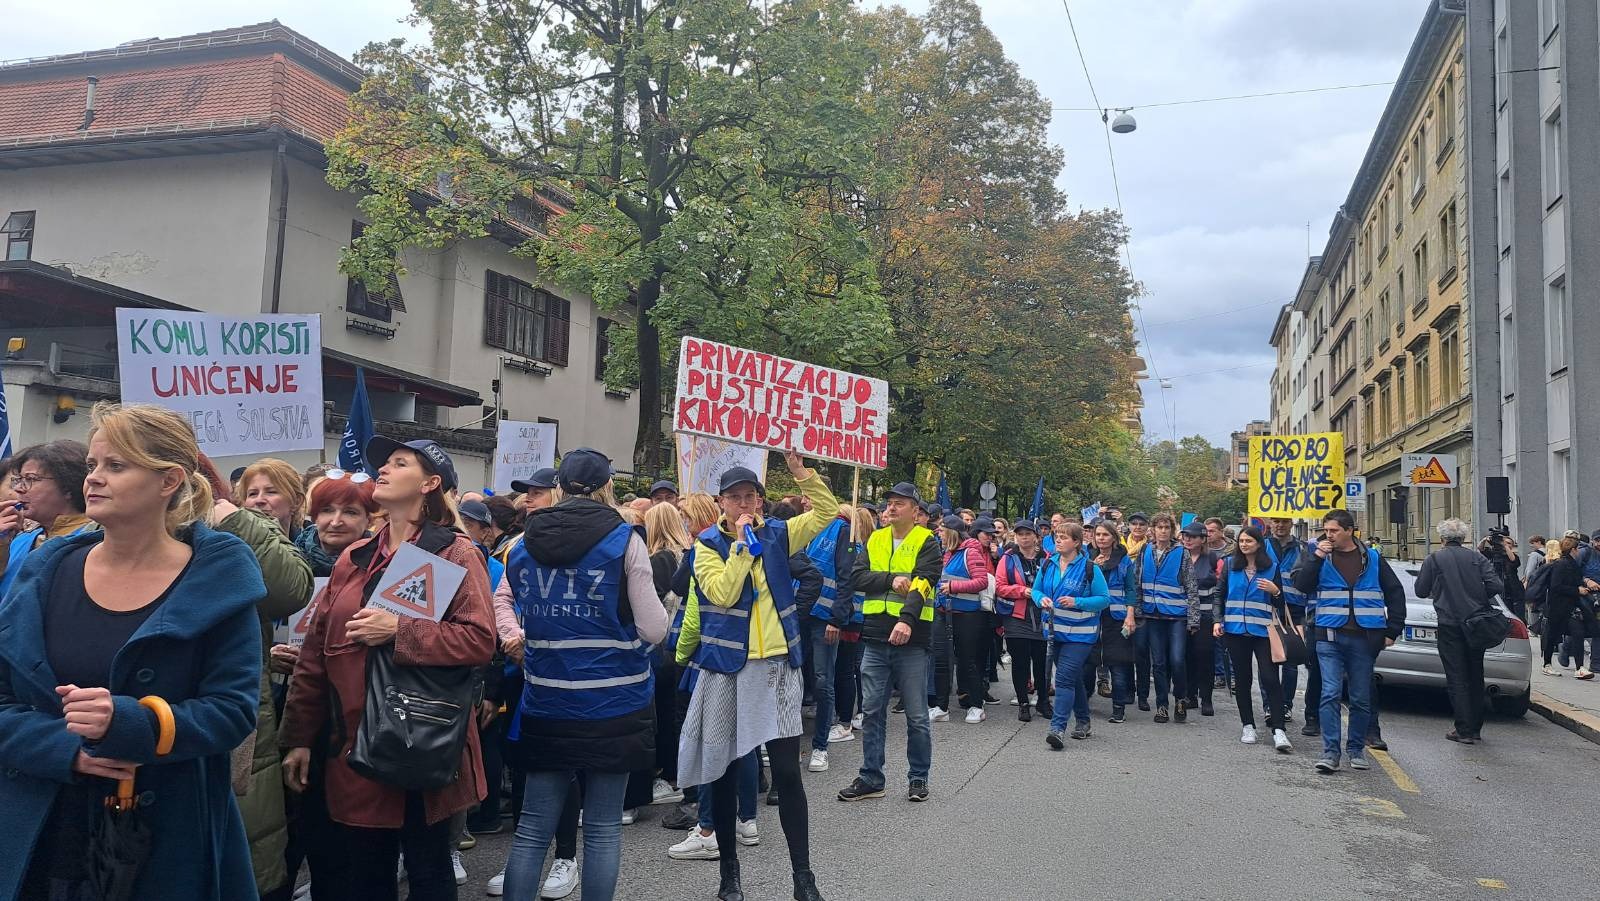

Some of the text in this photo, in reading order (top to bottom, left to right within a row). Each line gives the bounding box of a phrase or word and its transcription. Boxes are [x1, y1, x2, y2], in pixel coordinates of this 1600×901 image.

[130, 318, 310, 357] KOMU KORISTI
[151, 361, 299, 397] UNIČENJE
[686, 339, 872, 404] PRIVATIZACIJO
[236, 402, 312, 442] ŠOLSTVA
[678, 396, 798, 449] KAKOVOST
[811, 395, 878, 436] RAJE
[1261, 437, 1330, 462] KDO BO
[1259, 484, 1343, 512] OTROKE?
[519, 567, 606, 601] SVIZ
[1415, 628, 1426, 639] LJ
